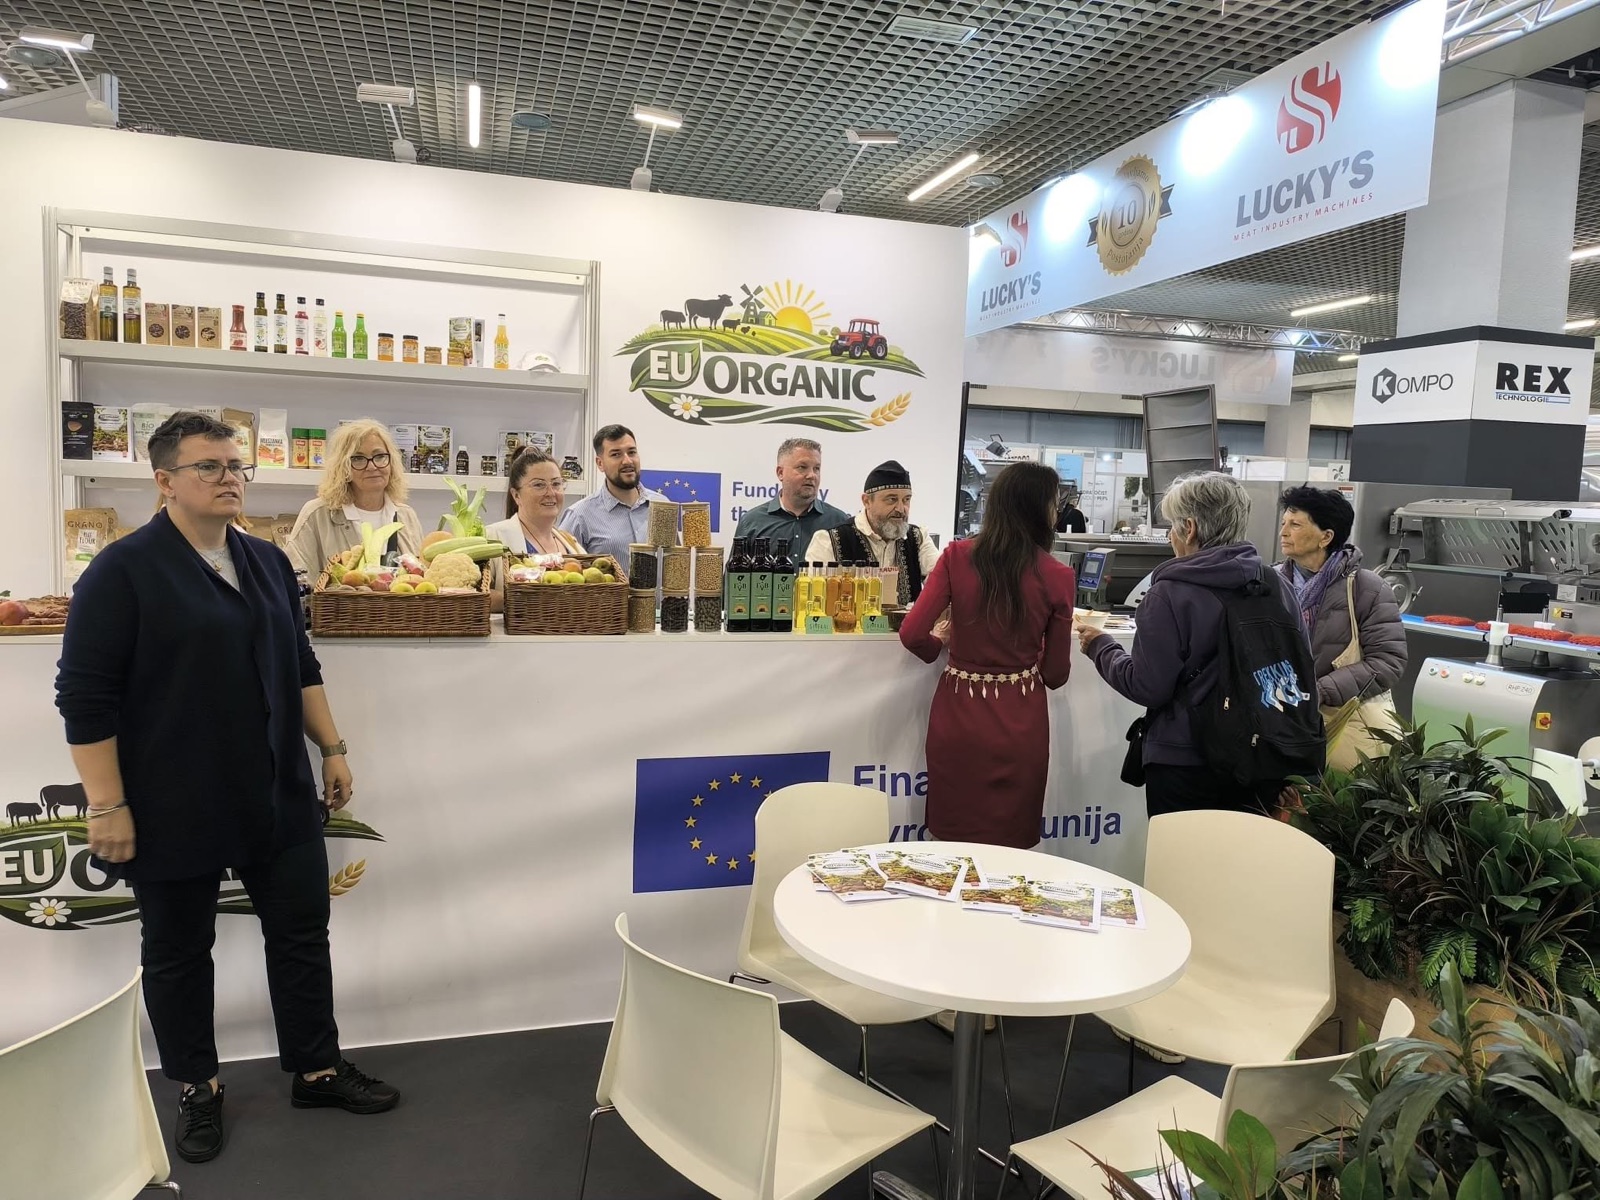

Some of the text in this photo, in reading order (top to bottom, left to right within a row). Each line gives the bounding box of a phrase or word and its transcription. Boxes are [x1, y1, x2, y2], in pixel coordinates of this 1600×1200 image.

[1236, 150, 1374, 228] LUCKY'S
[1117, 200, 1137, 229] 10
[1233, 192, 1373, 241] MEAT INDUSTRY MACHINES
[981, 271, 1041, 312] LUCKY'S
[650, 350, 877, 402] EU ORGANIC
[1372, 368, 1454, 404] KOMPO
[1495, 362, 1572, 395] REX
[732, 481, 781, 498] Fund
[731, 506, 748, 521] th
[1040, 806, 1121, 844] unija
[1, 849, 54, 885] EU
